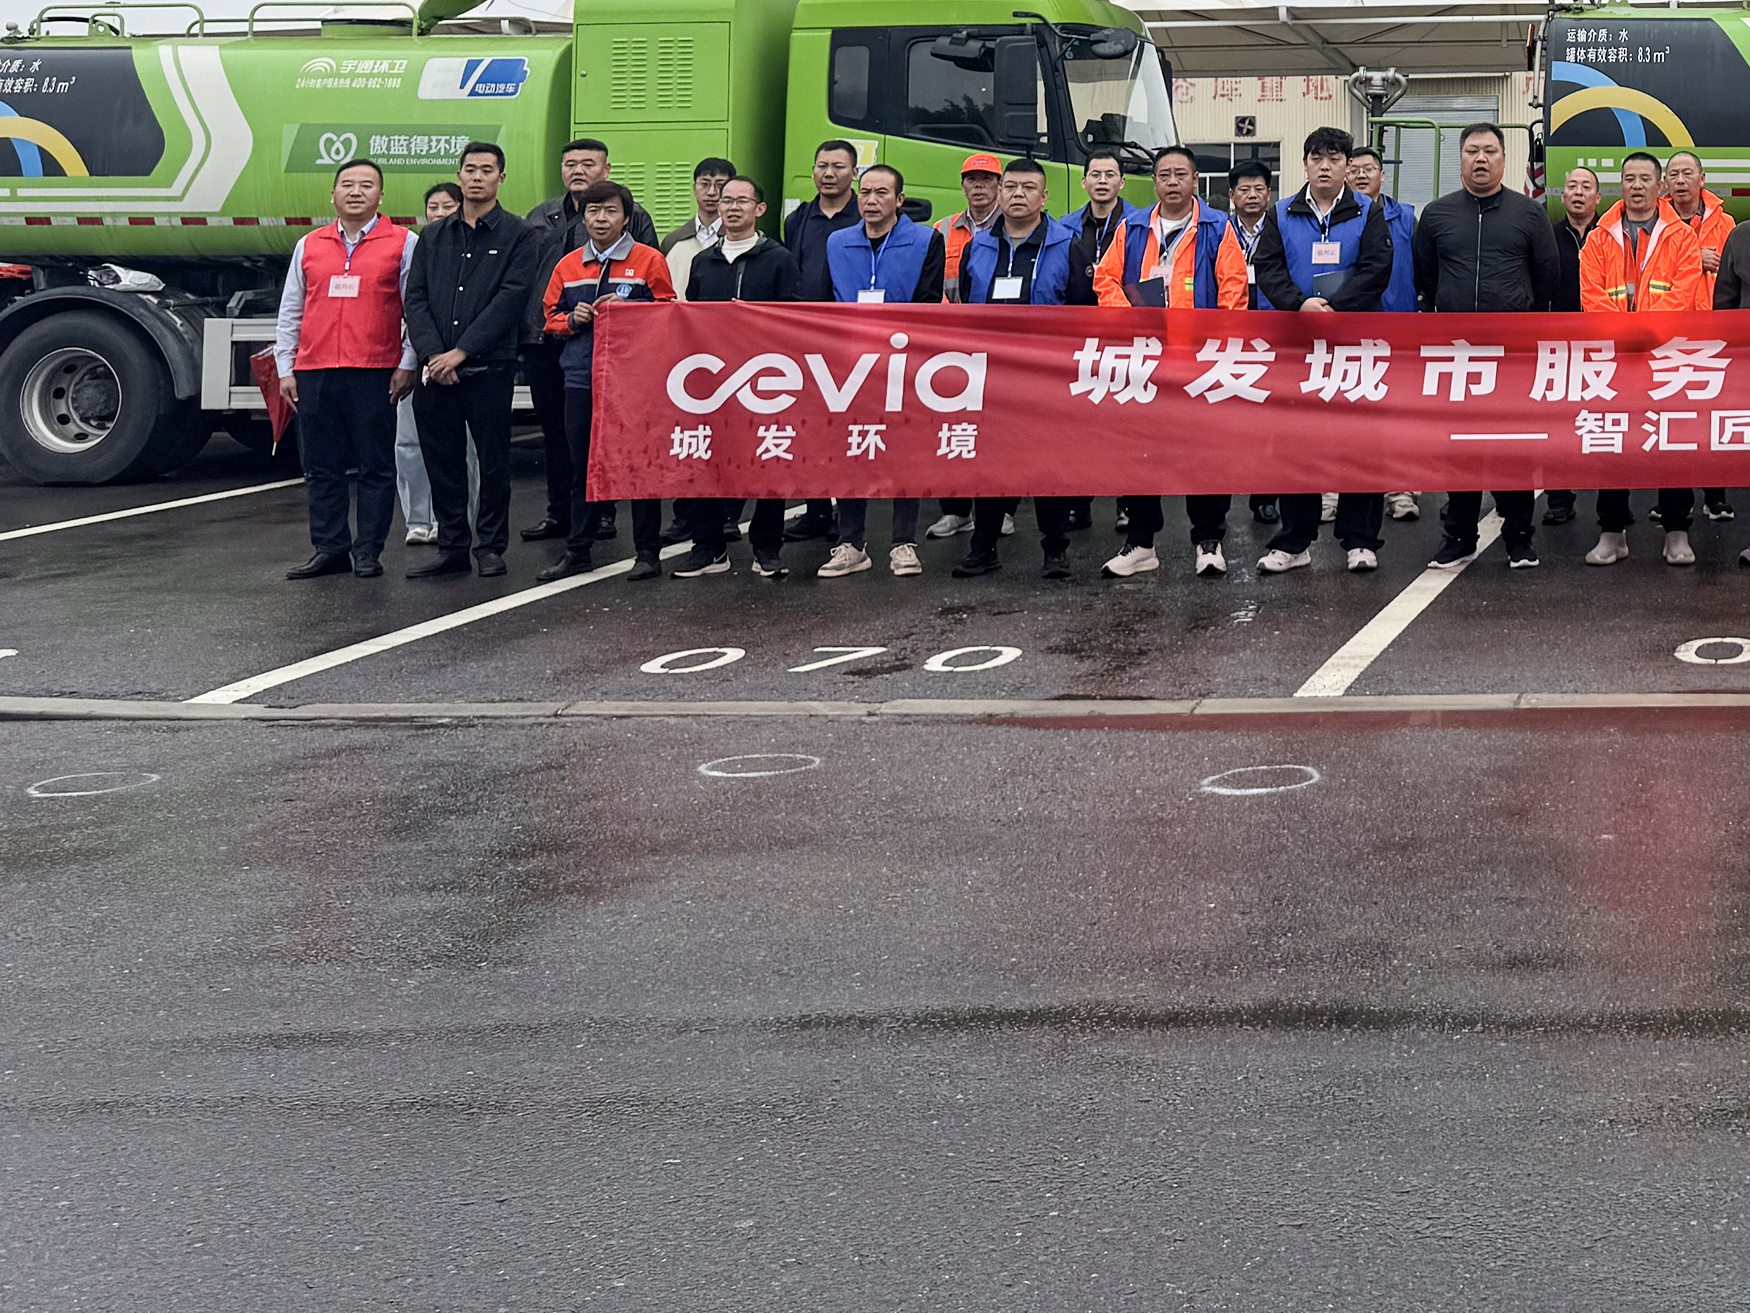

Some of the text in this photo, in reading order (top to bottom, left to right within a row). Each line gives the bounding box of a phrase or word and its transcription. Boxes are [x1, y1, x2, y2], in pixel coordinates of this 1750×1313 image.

[340, 60, 408, 73] 宇通环卫
[474, 83, 516, 94] 电动汽车
[369, 135, 470, 156] 傲蓝得环境
[667, 332, 988, 414] cevia
[670, 422, 978, 460] 城发环境
